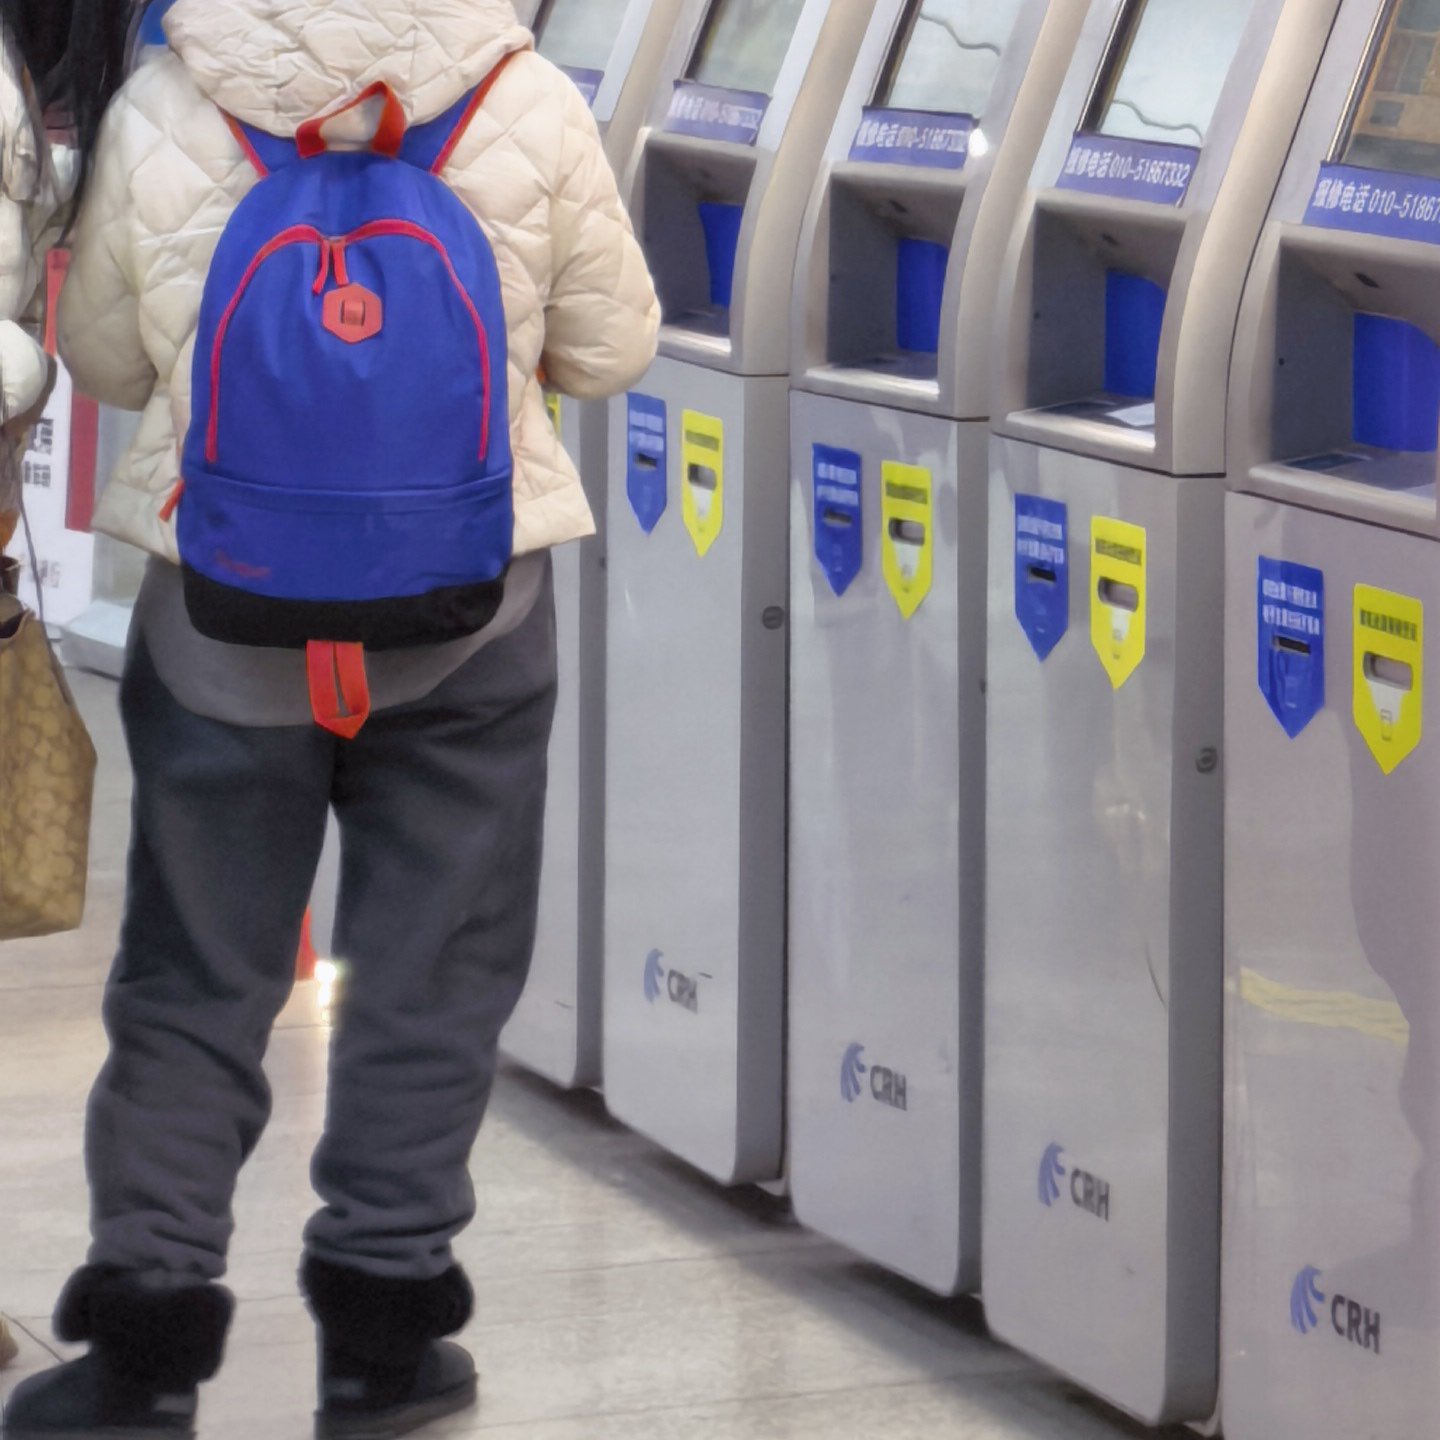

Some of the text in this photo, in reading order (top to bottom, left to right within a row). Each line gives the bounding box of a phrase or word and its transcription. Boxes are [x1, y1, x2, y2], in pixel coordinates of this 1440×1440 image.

[870, 1064, 908, 1112] CRH
[1069, 1167, 1111, 1222] CRH
[1331, 1293, 1382, 1355] CRH
